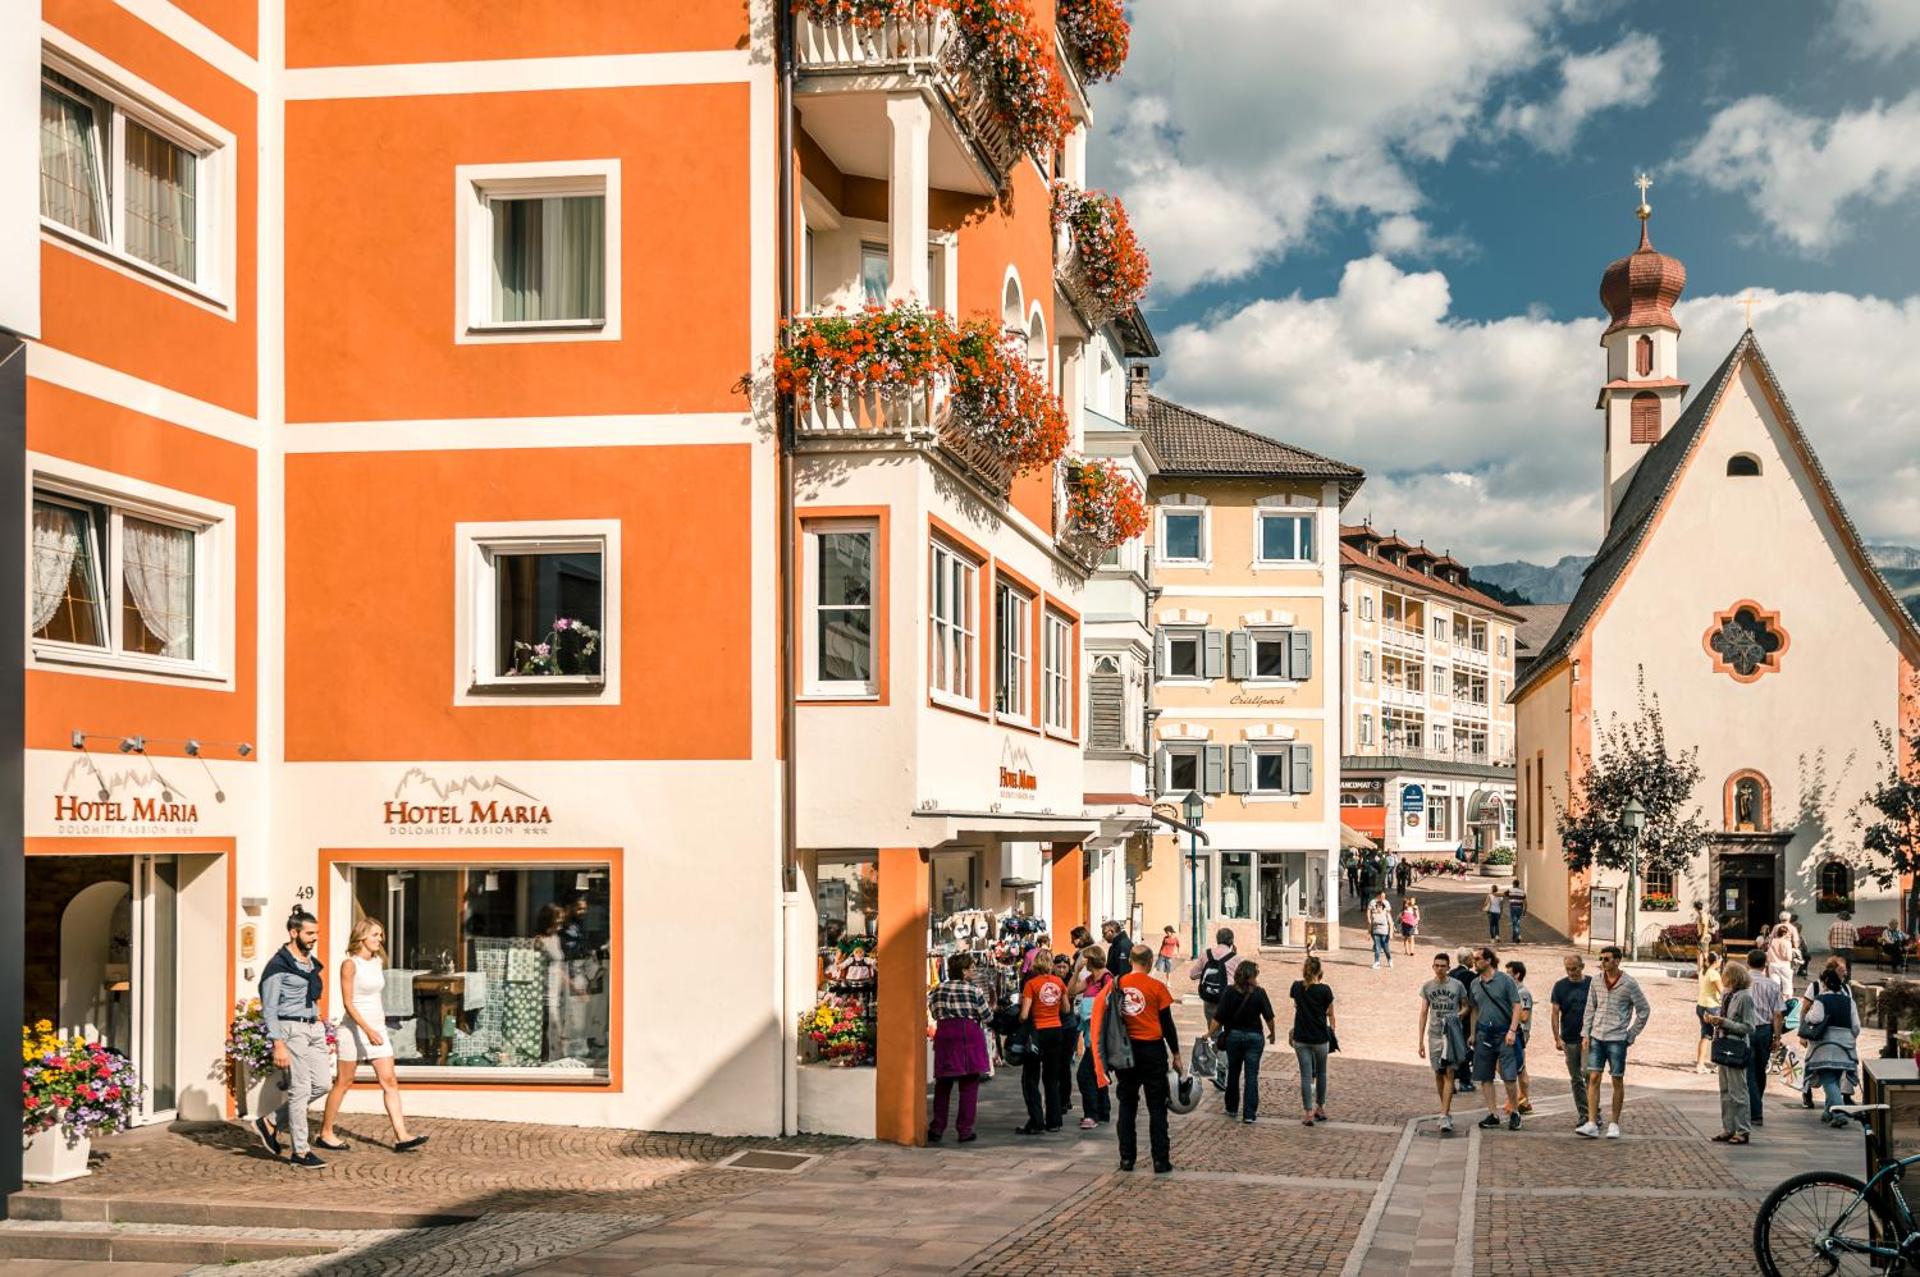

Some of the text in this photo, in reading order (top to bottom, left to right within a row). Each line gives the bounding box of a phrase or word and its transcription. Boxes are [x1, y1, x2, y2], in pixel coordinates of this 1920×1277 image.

[54, 795, 199, 823] HOTEL MARIA
[384, 801, 553, 824] HOTEL MARIA
[58, 825, 167, 835] DOLOMITI PASSION
[389, 826, 514, 836] DOLOMITI PASSION
[295, 885, 315, 900] 49
